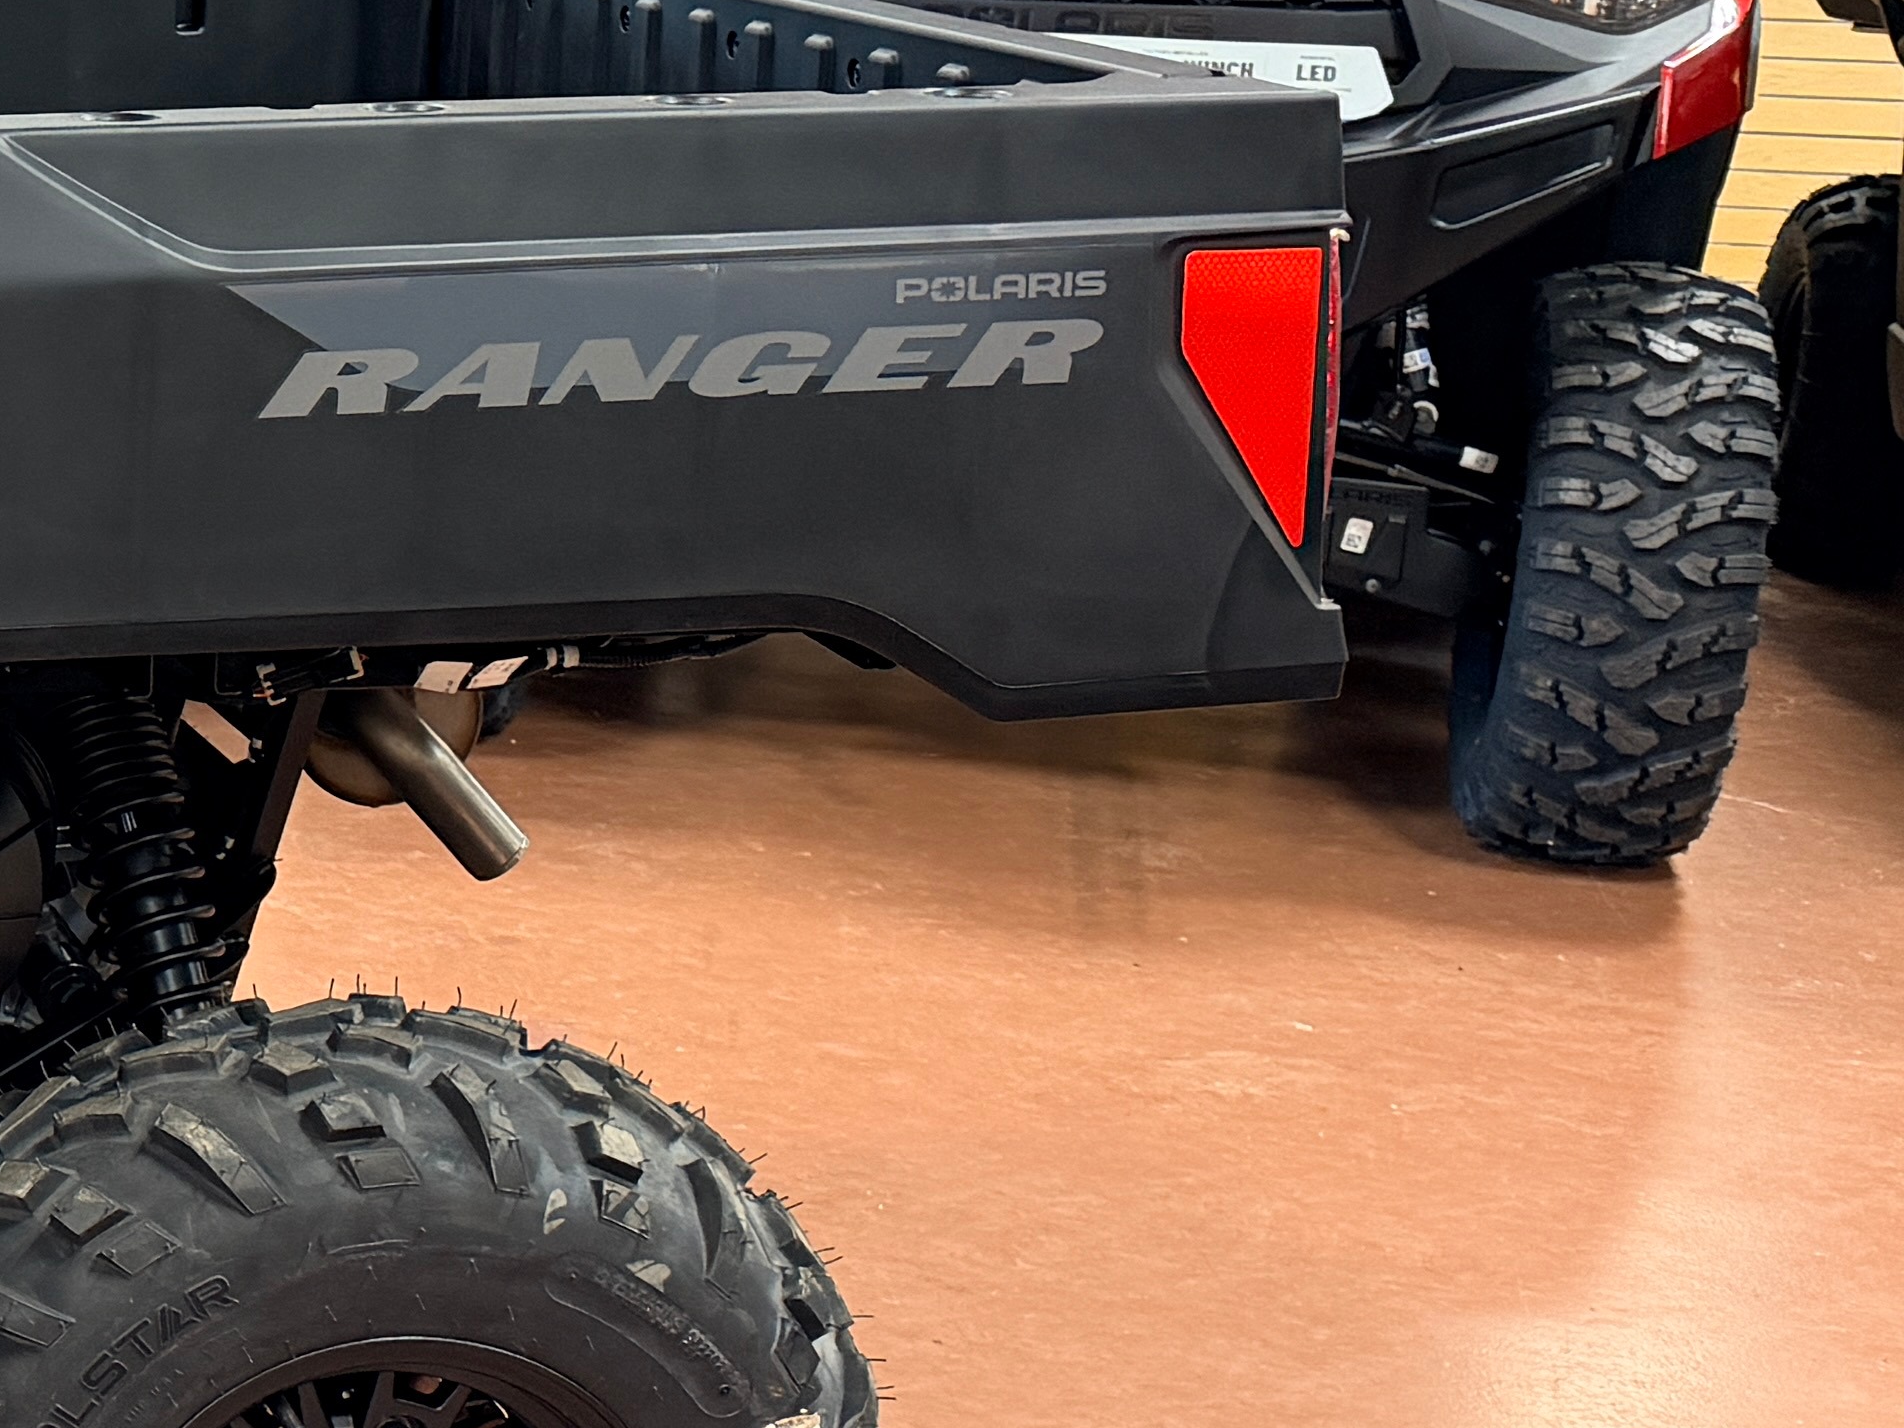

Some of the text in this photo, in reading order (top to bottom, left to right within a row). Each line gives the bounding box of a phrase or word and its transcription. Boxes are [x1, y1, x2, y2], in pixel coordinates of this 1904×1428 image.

[1296, 63, 1336, 83] LED
[895, 269, 1108, 304] POLARIS
[258, 318, 1106, 420] RANGER
